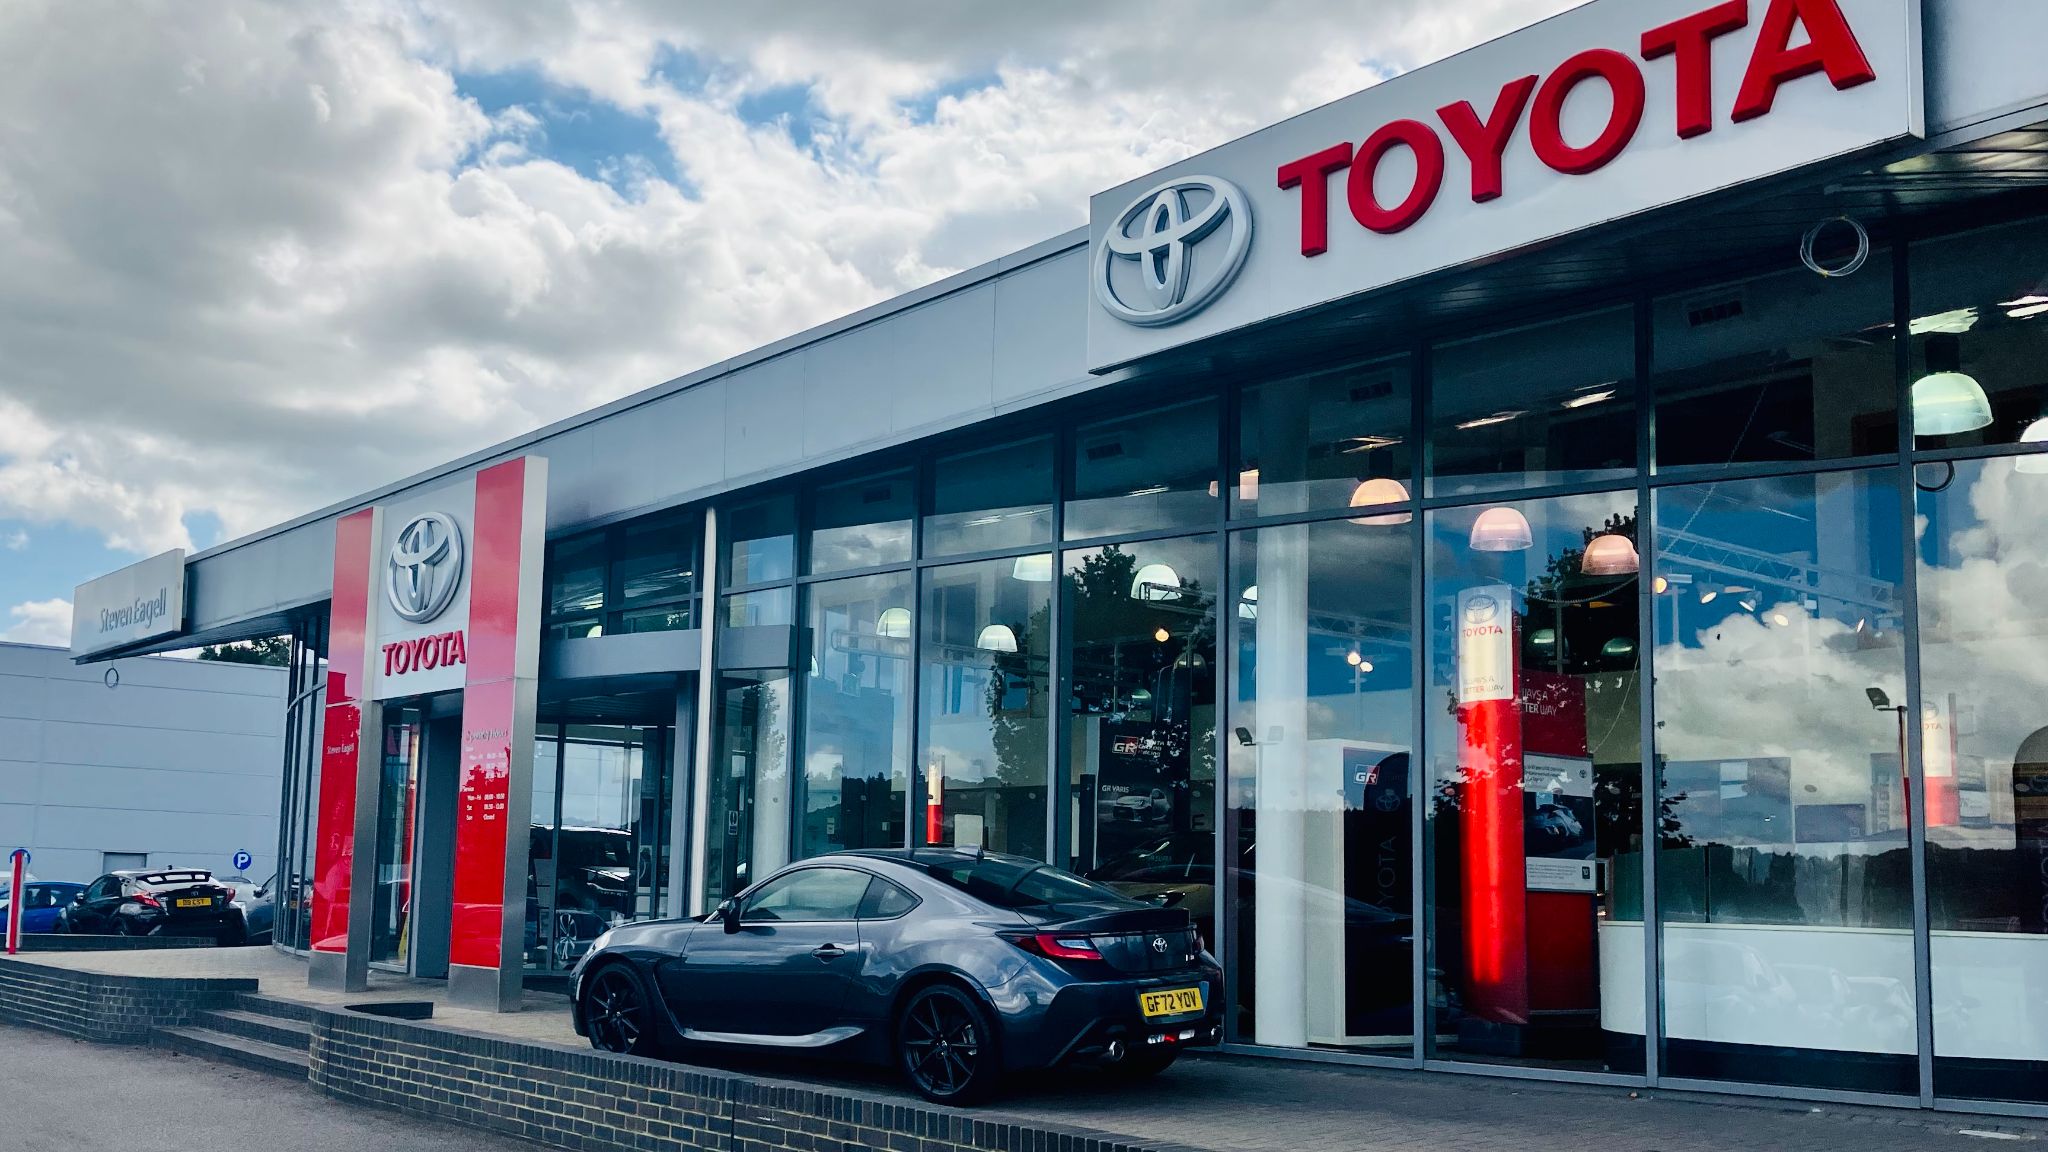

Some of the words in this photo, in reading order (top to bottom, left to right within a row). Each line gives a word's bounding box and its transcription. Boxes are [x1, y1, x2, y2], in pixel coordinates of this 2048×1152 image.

[1278, 0, 1876, 258] TOYOTA
[100, 607, 133, 633] Steven
[133, 586, 167, 629] Eagell
[1462, 625, 1503, 637] TOYOTA
[382, 630, 466, 676] TOYOTA
[1114, 742, 1137, 753] GR
[1355, 772, 1377, 784] GR
[237, 853, 249, 868] P
[1146, 993, 1175, 1012] GF72
[1176, 991, 1197, 1009] YOV
